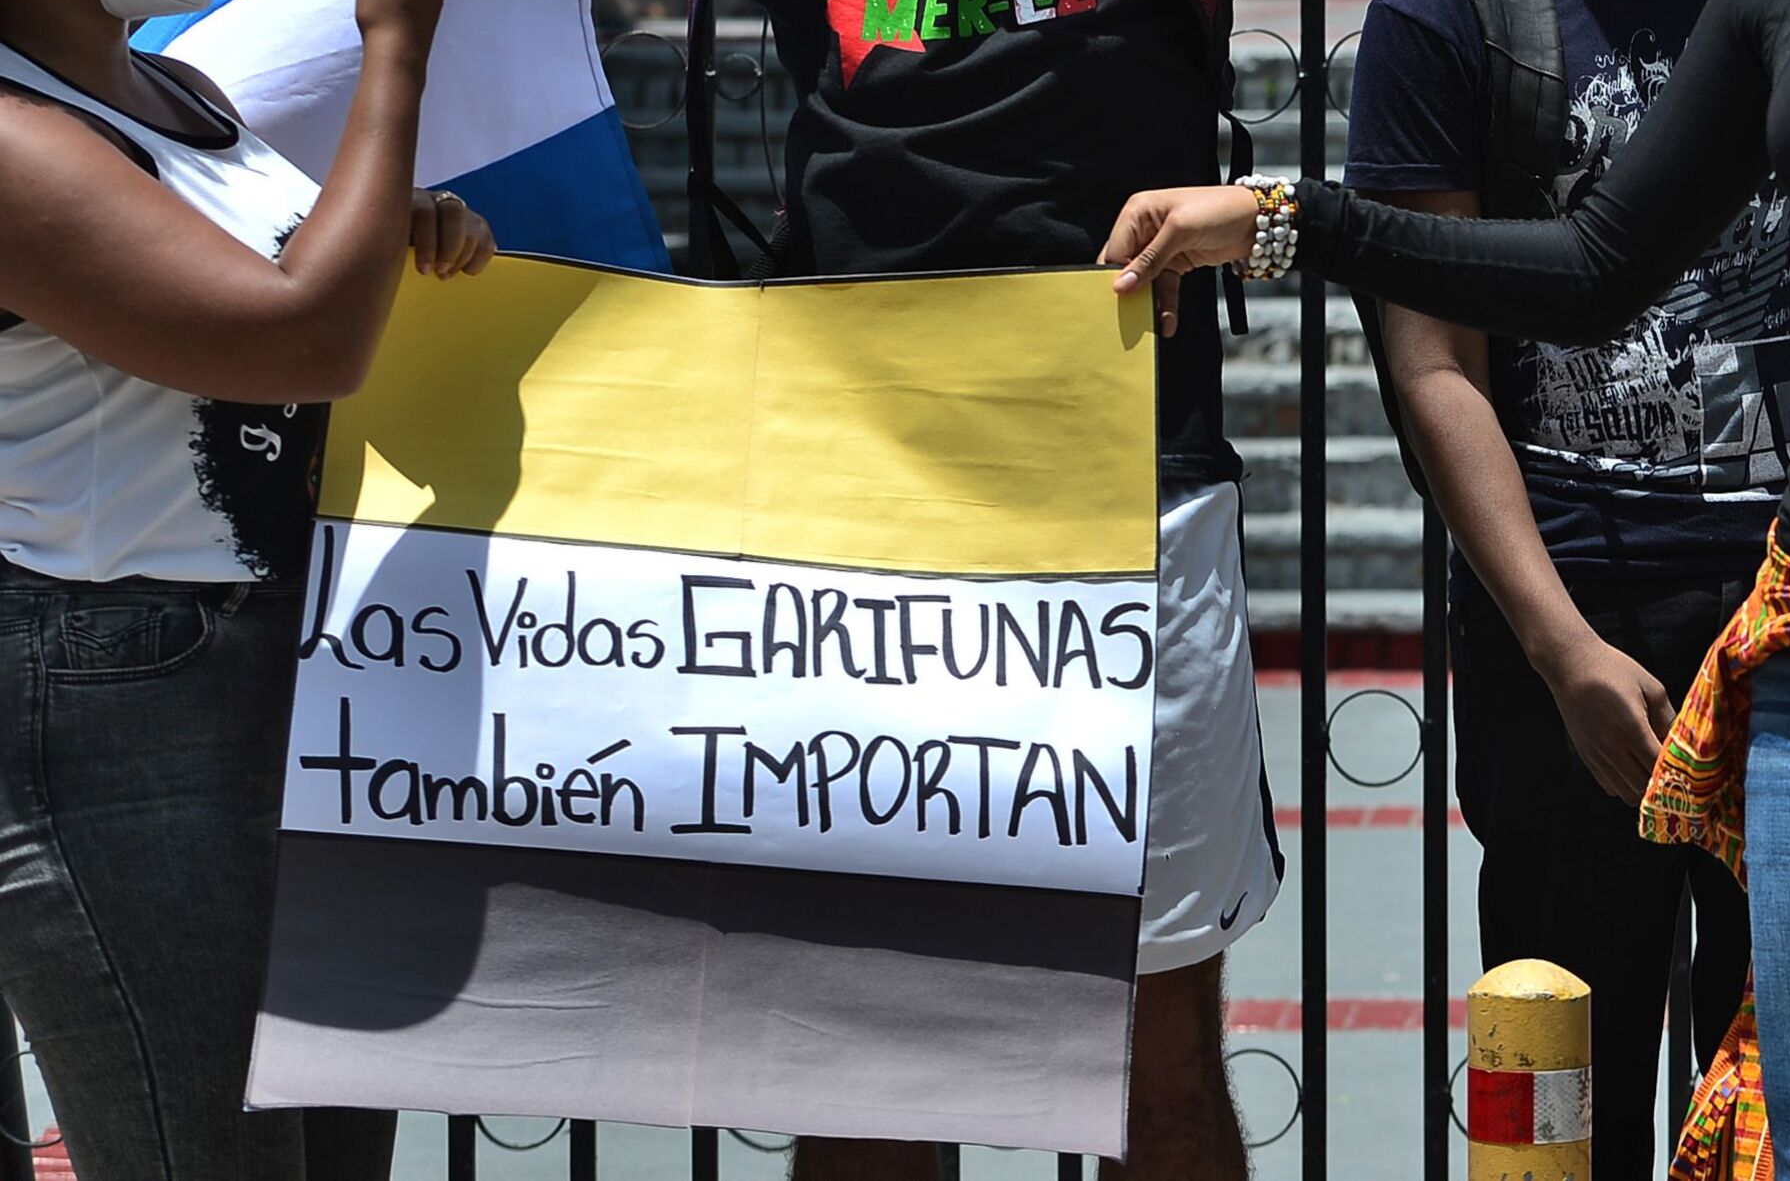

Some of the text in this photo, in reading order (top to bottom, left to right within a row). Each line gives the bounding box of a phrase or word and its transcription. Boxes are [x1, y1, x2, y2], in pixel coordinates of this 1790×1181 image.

[297, 523, 1153, 691] Las Vidas GARIFUNAS
[298, 696, 1138, 847] también IMPORTAN
